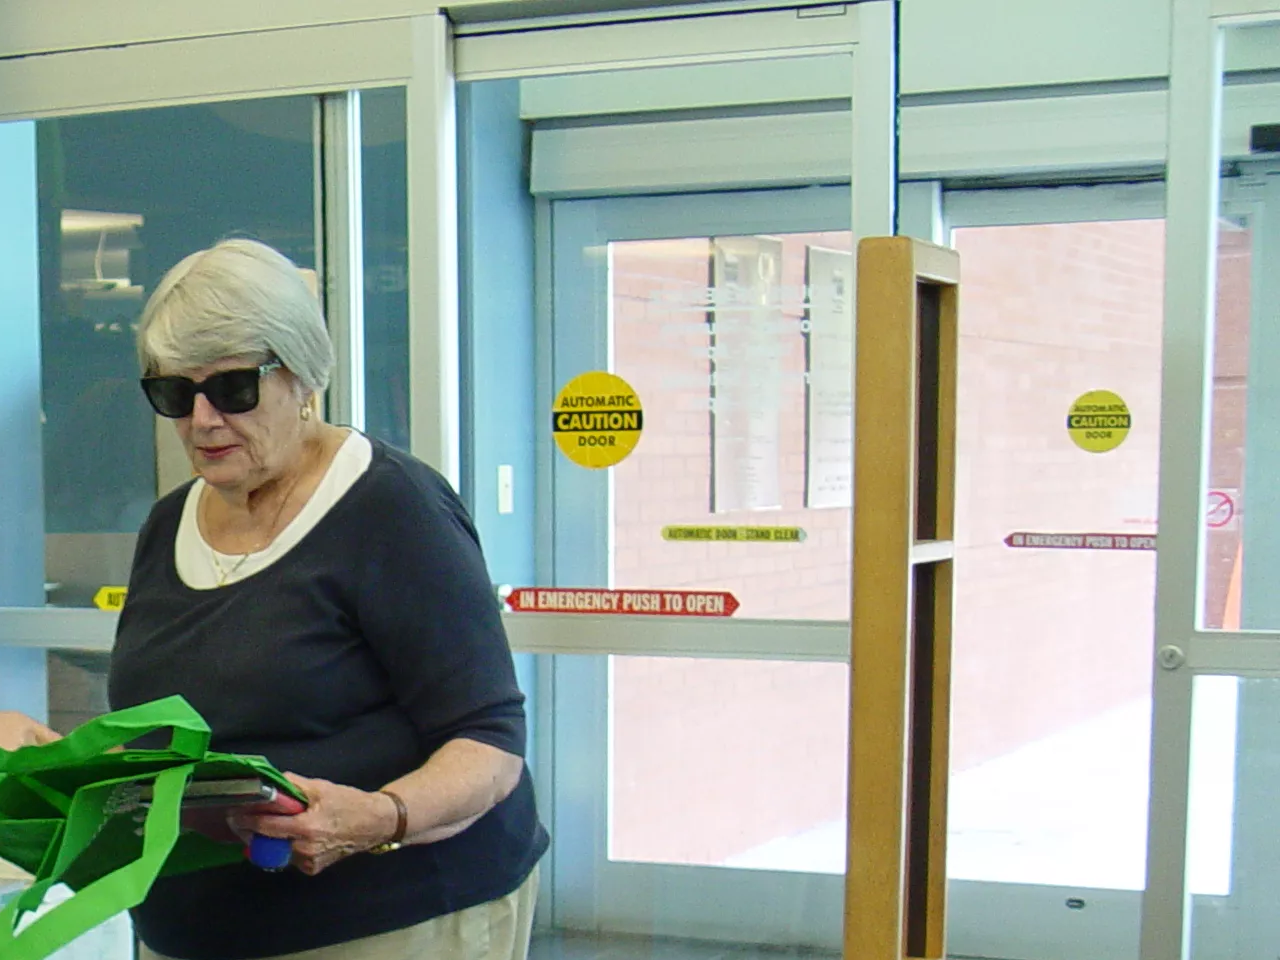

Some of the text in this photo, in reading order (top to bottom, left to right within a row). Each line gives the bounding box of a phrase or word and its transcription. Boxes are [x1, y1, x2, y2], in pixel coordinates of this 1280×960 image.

[561, 395, 634, 408] AUTOMATIC
[1074, 404, 1127, 412] AUTOMATIC
[557, 412, 638, 430] CAUTION
[1071, 416, 1129, 427] CAUTION
[578, 435, 616, 447] DOOR
[1085, 431, 1112, 439] DOOR
[667, 528, 712, 540] AUTOMATIC
[520, 590, 724, 613] IN EMERGENCY PUSH TO OPEN
